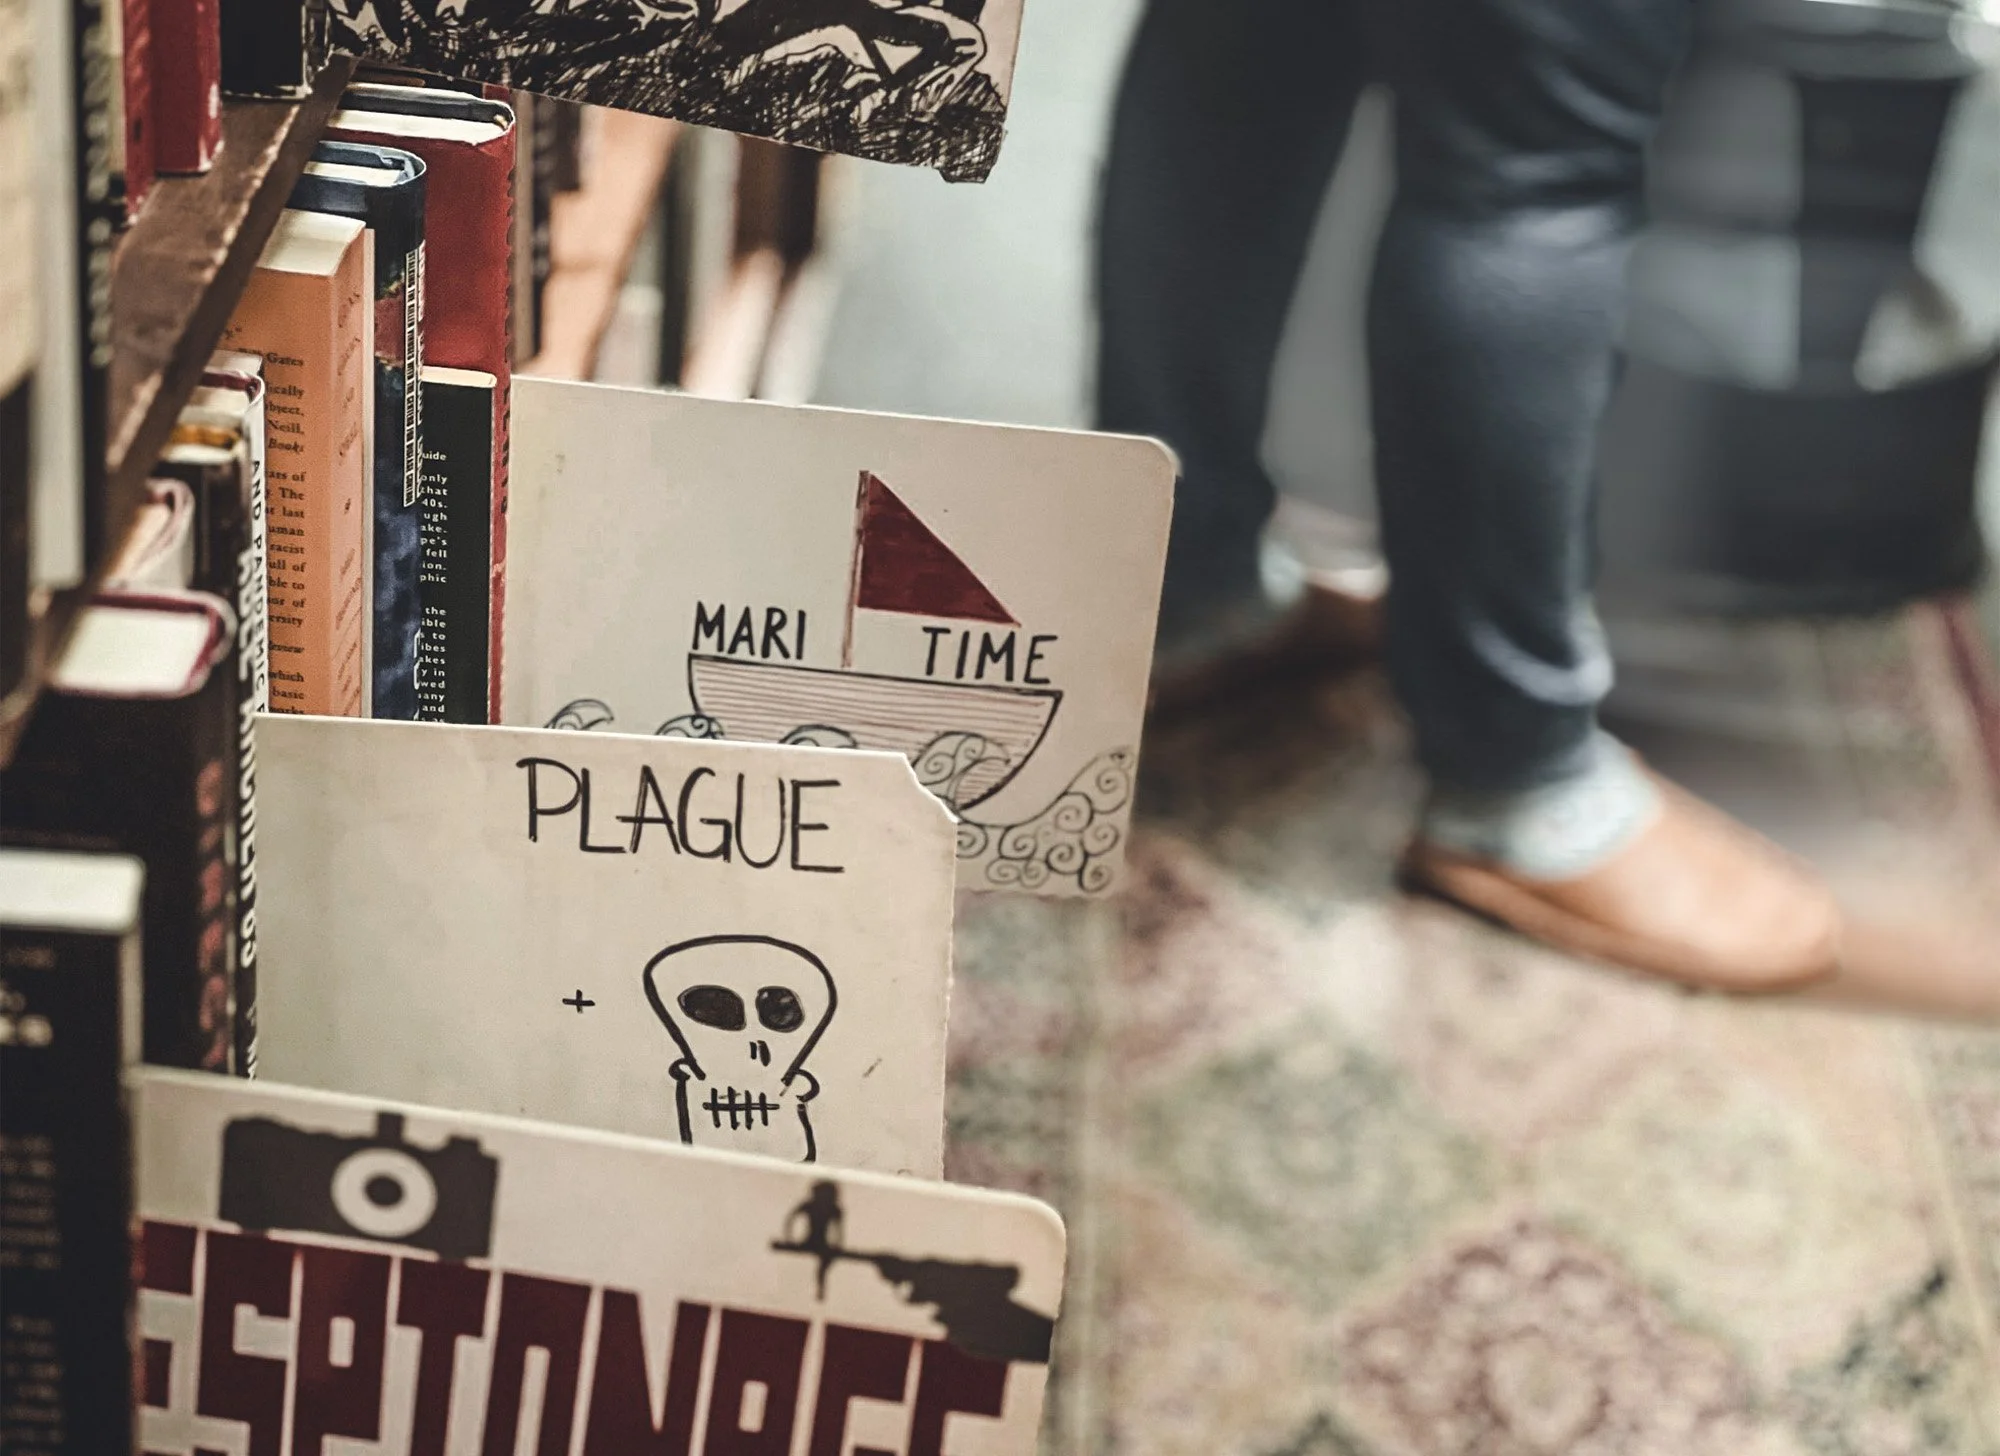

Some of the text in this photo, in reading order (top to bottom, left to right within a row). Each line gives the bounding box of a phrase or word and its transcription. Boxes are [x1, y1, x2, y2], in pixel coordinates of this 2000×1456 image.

[292, 471, 307, 482] of
[420, 474, 448, 485] only
[252, 460, 262, 520] AND
[278, 486, 305, 501] The
[282, 506, 305, 519] last
[270, 543, 305, 555] racist
[425, 548, 448, 559] fell
[292, 562, 307, 573] of
[292, 583, 305, 592] to
[292, 599, 306, 609] of
[254, 534, 265, 691] PANDEMIC
[425, 606, 447, 616] the
[432, 631, 446, 640] to
[692, 600, 1058, 685] MARI TIME
[433, 667, 446, 677] in
[272, 686, 305, 700] basic
[422, 703, 446, 714] and
[516, 757, 845, 864] PLAGUE
